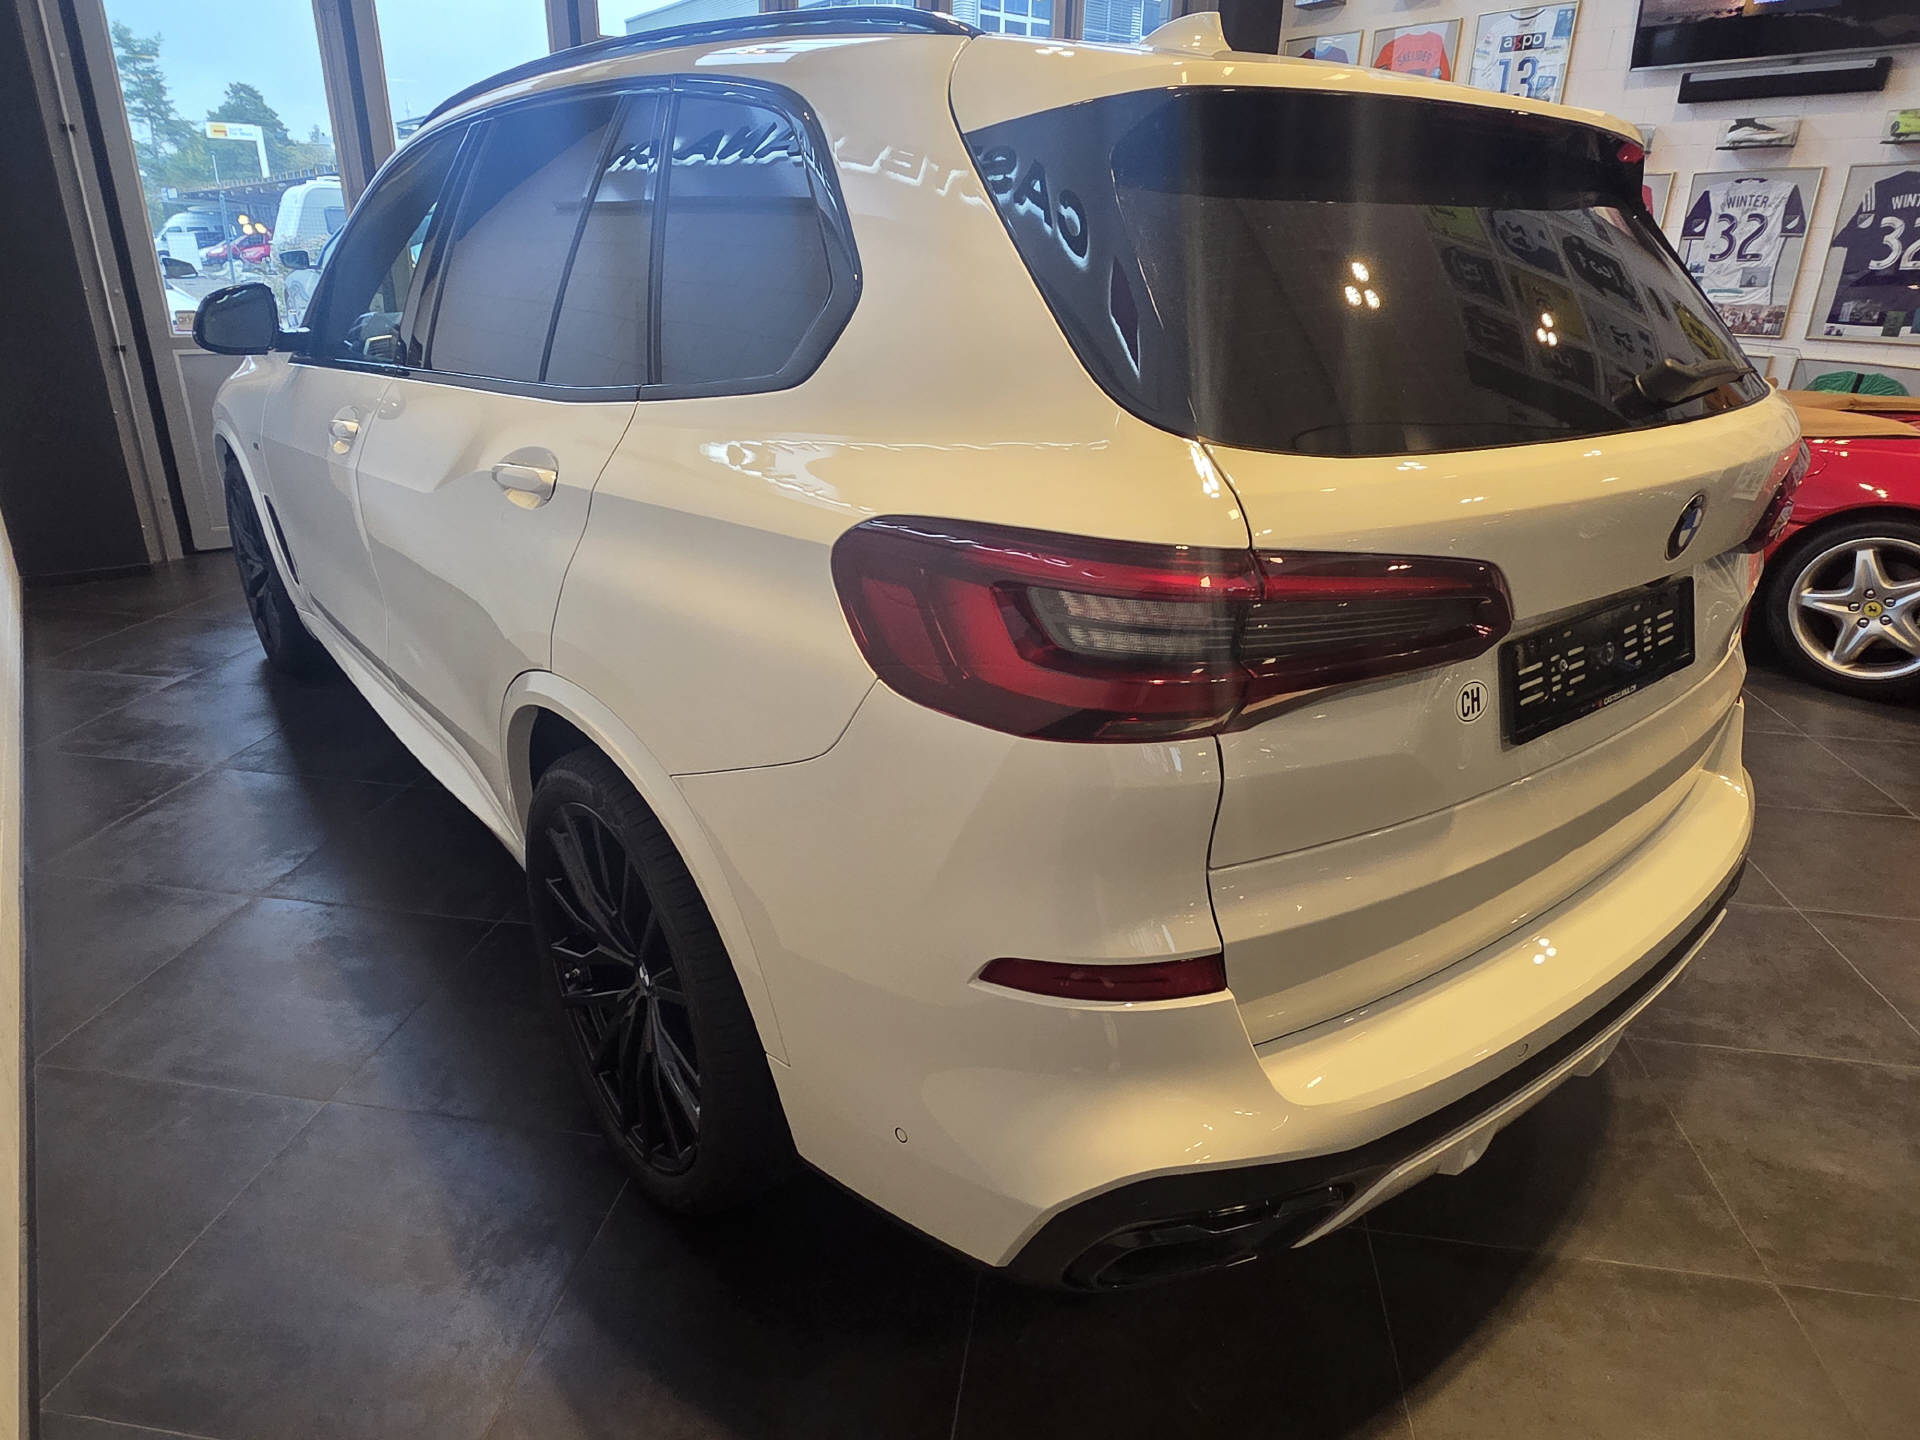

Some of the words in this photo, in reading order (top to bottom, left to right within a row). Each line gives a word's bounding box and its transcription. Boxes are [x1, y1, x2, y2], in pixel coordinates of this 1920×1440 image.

[1498, 56, 1539, 98] 13
[1727, 194, 1769, 209] WINTER
[1708, 213, 1769, 262] 32
[1461, 686, 1481, 717] CH
